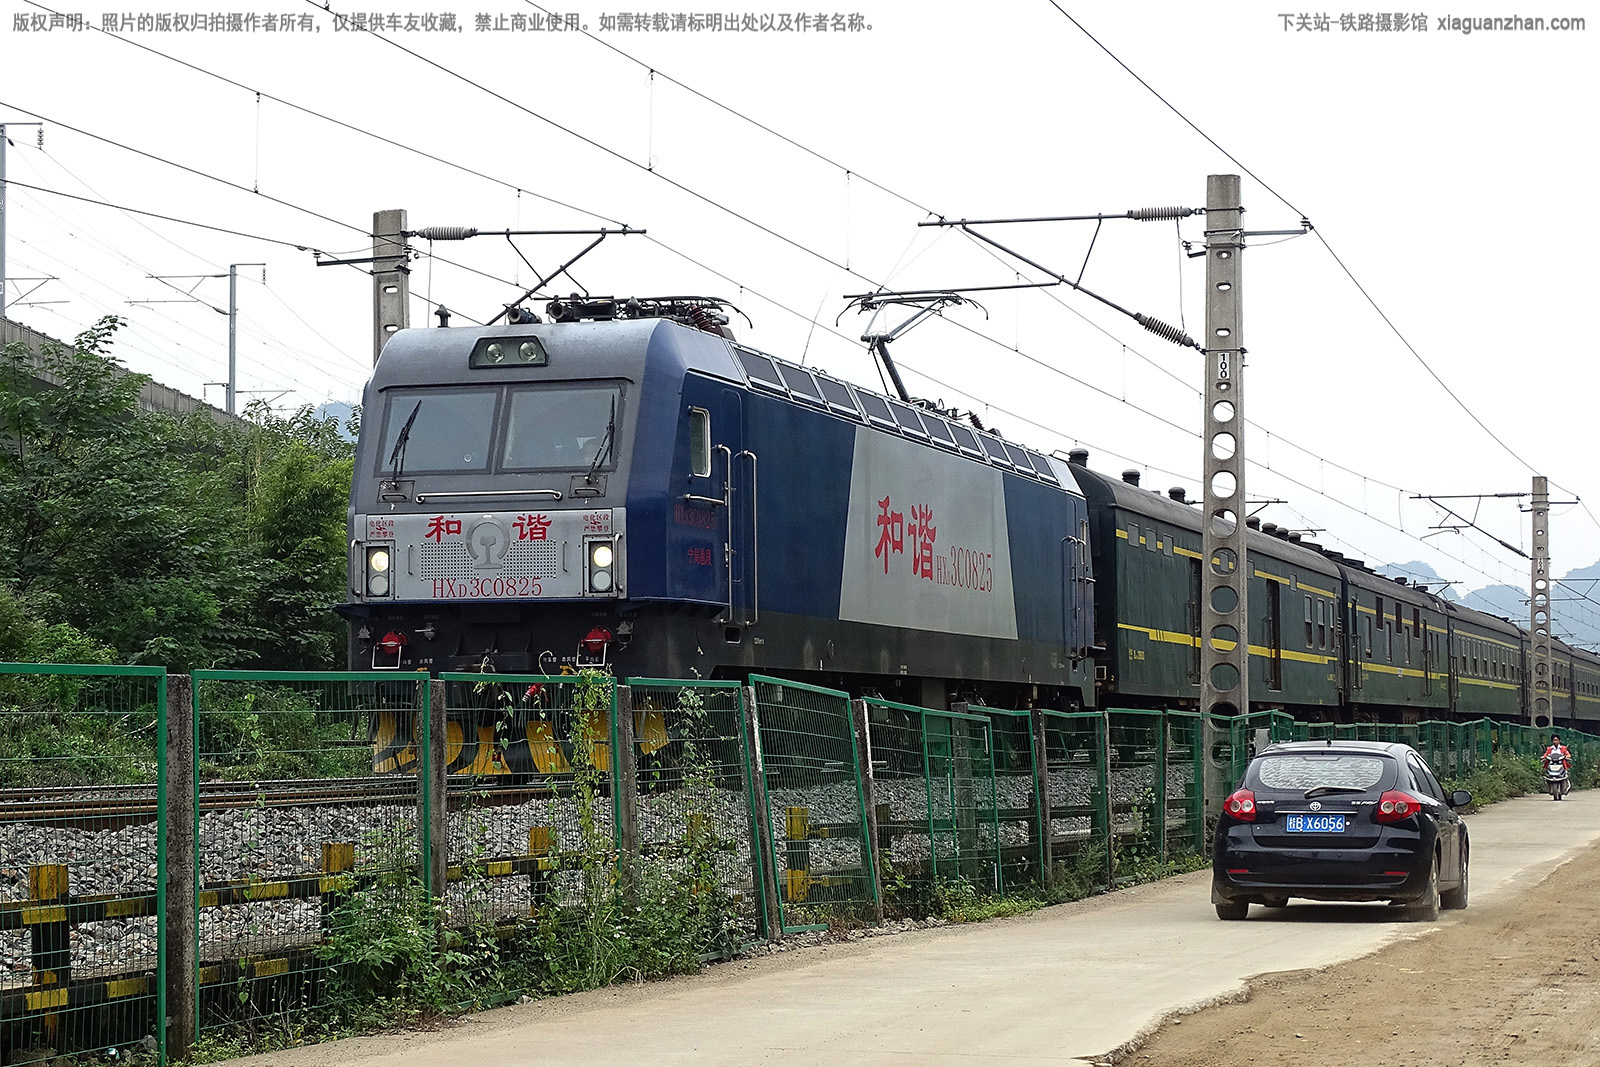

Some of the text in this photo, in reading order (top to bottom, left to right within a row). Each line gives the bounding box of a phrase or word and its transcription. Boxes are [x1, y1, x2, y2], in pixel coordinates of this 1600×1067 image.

[1220, 353, 1228, 379] 100
[875, 495, 937, 581] 和谐
[432, 577, 543, 599] HXD3C0825
